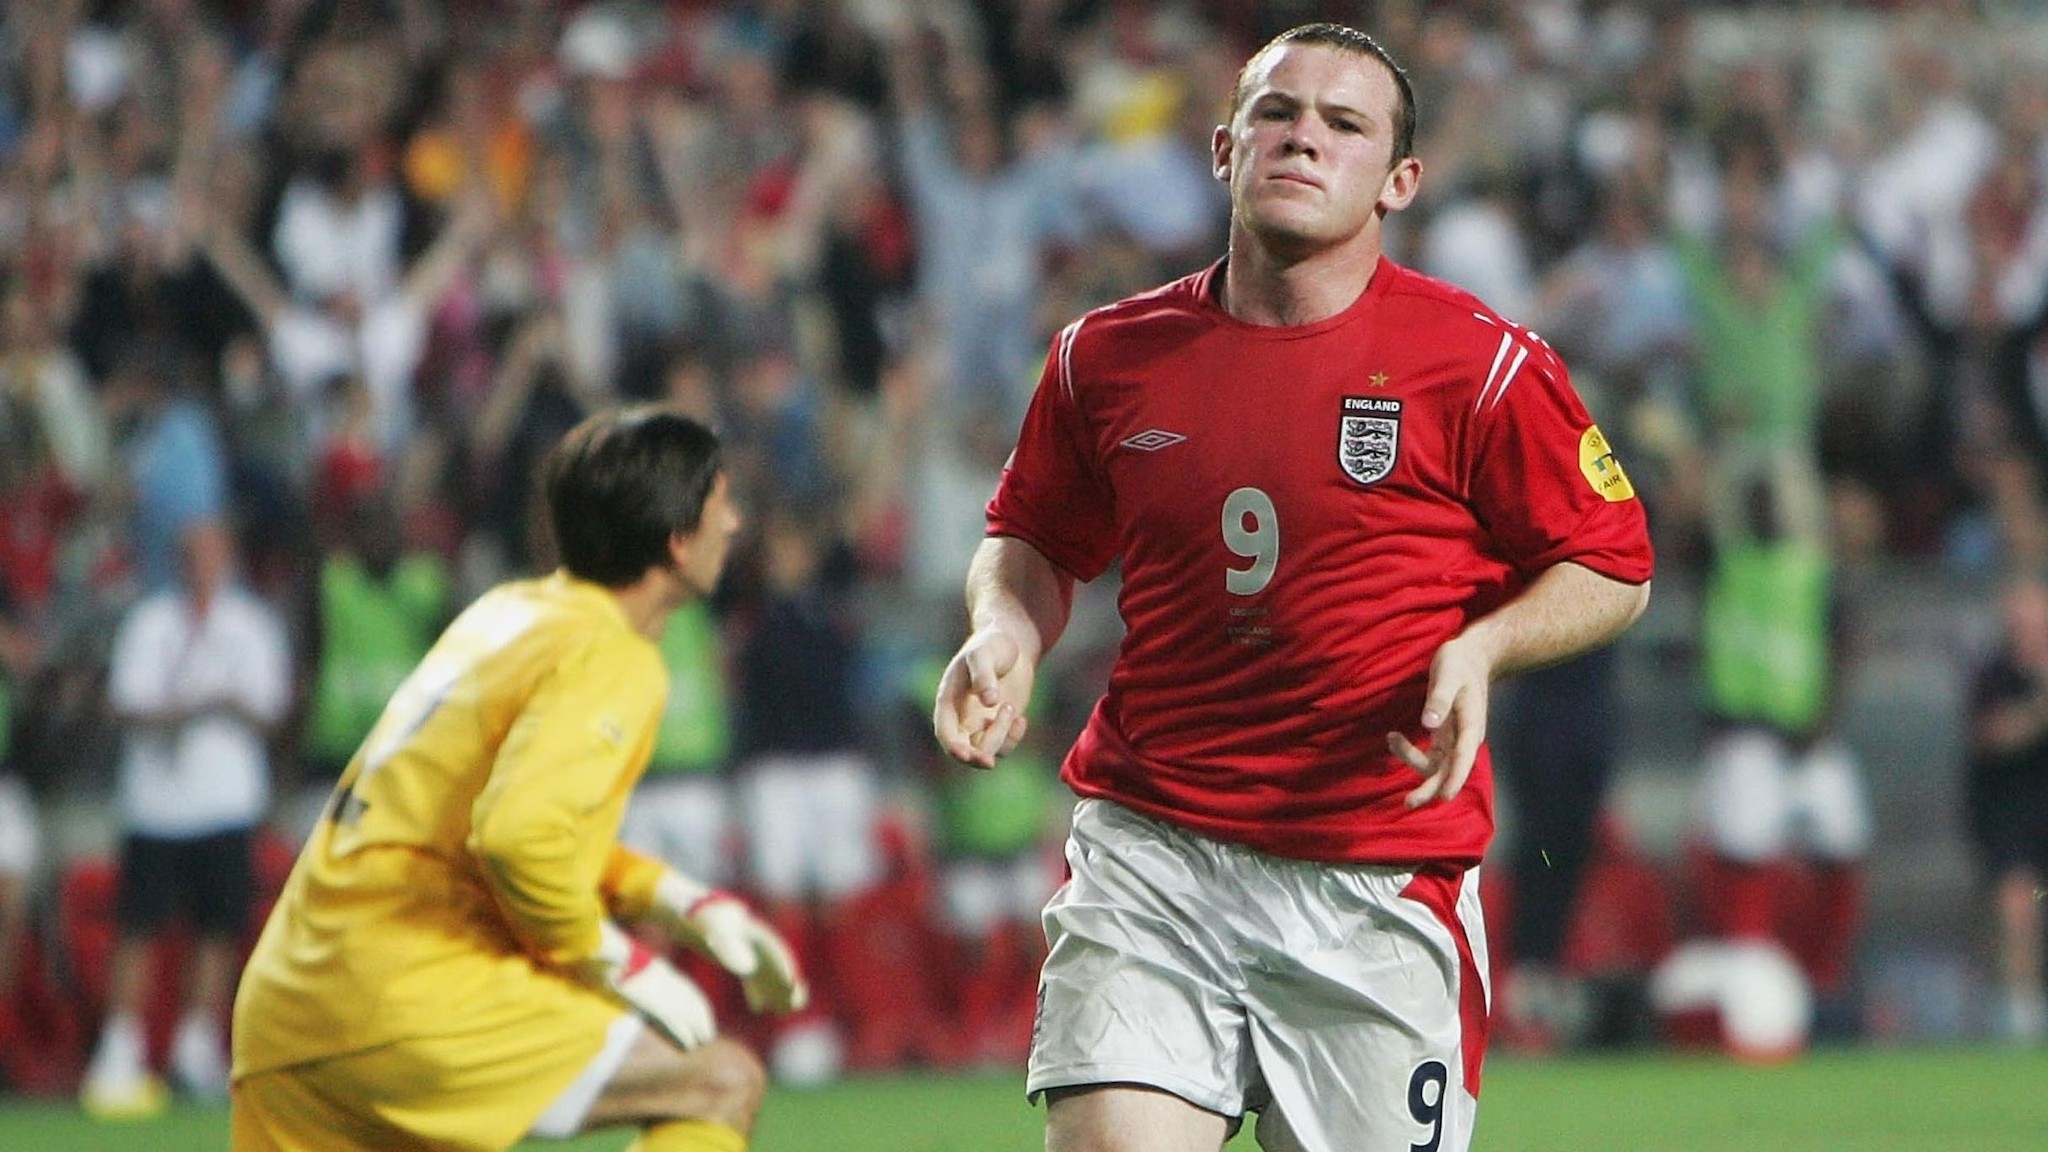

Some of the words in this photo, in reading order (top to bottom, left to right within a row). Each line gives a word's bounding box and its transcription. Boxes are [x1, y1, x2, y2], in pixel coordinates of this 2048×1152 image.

[1344, 398, 1400, 413] ENGLAND
[1221, 486, 1280, 596] 9
[1406, 1059, 1448, 1152] 9
